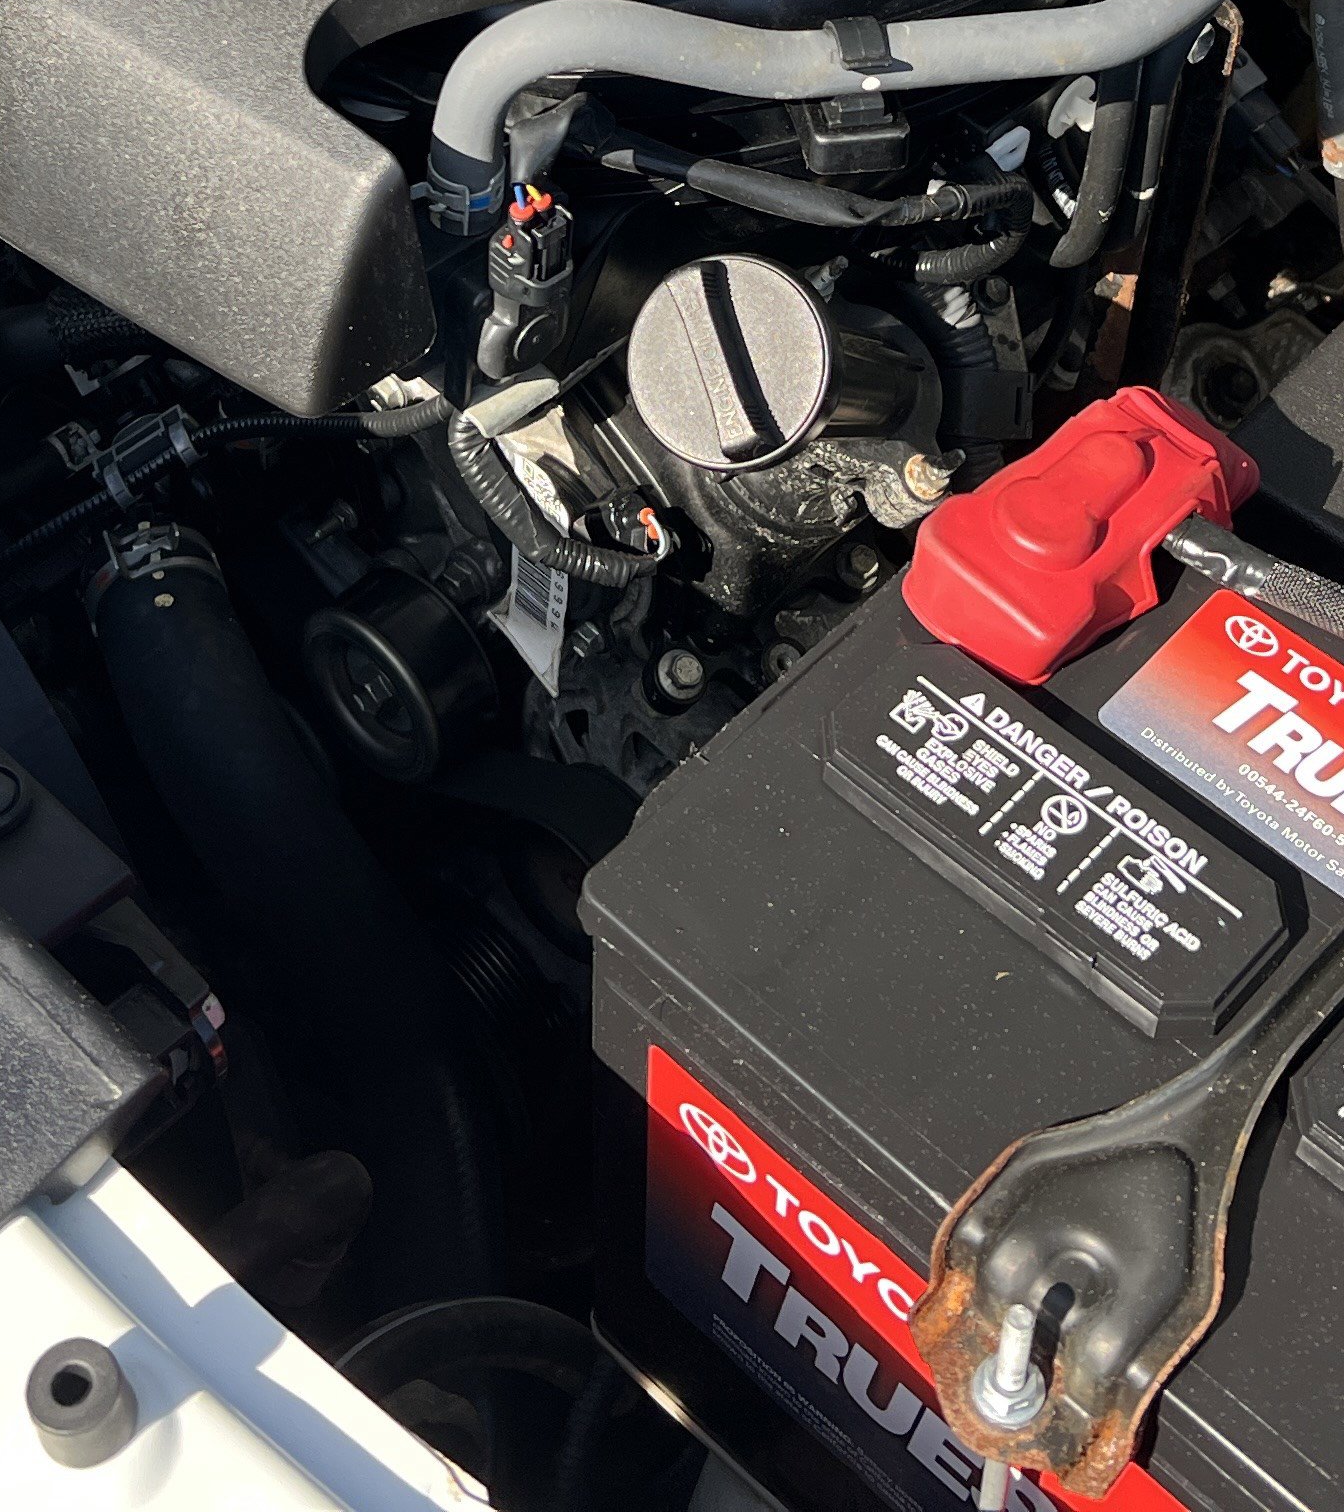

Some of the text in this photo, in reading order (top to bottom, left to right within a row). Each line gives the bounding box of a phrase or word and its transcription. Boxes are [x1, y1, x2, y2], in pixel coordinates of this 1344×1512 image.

[876, 735, 979, 816] CAN CAUSE BLINDNESS
[916, 748, 960, 783] GASES
[925, 737, 996, 794] EXPLOSIVE
[962, 749, 999, 779] EYES
[972, 739, 1021, 778] SHIELD
[896, 765, 947, 805] OR INJURY
[984, 706, 1090, 789] DANGER
[1106, 795, 1208, 875] POISON
[1140, 727, 1217, 782] Distributed
[1215, 778, 1235, 797] by
[1234, 791, 1279, 830] Toyota
[1281, 824, 1324, 865] Motor
[1006, 833, 1048, 866] FLAMES
[1016, 824, 1057, 859] SPARKS
[1033, 820, 1056, 841] NO
[998, 842, 1045, 880] SMOKING
[1074, 900, 1152, 962] SEVERE BURNS
[1083, 891, 1160, 953] BLINDNESS OR
[1092, 882, 1153, 932] CAN CAUSE
[1100, 872, 1201, 952] SULFURIC ACID
[765, 1176, 917, 1322] TOYO
